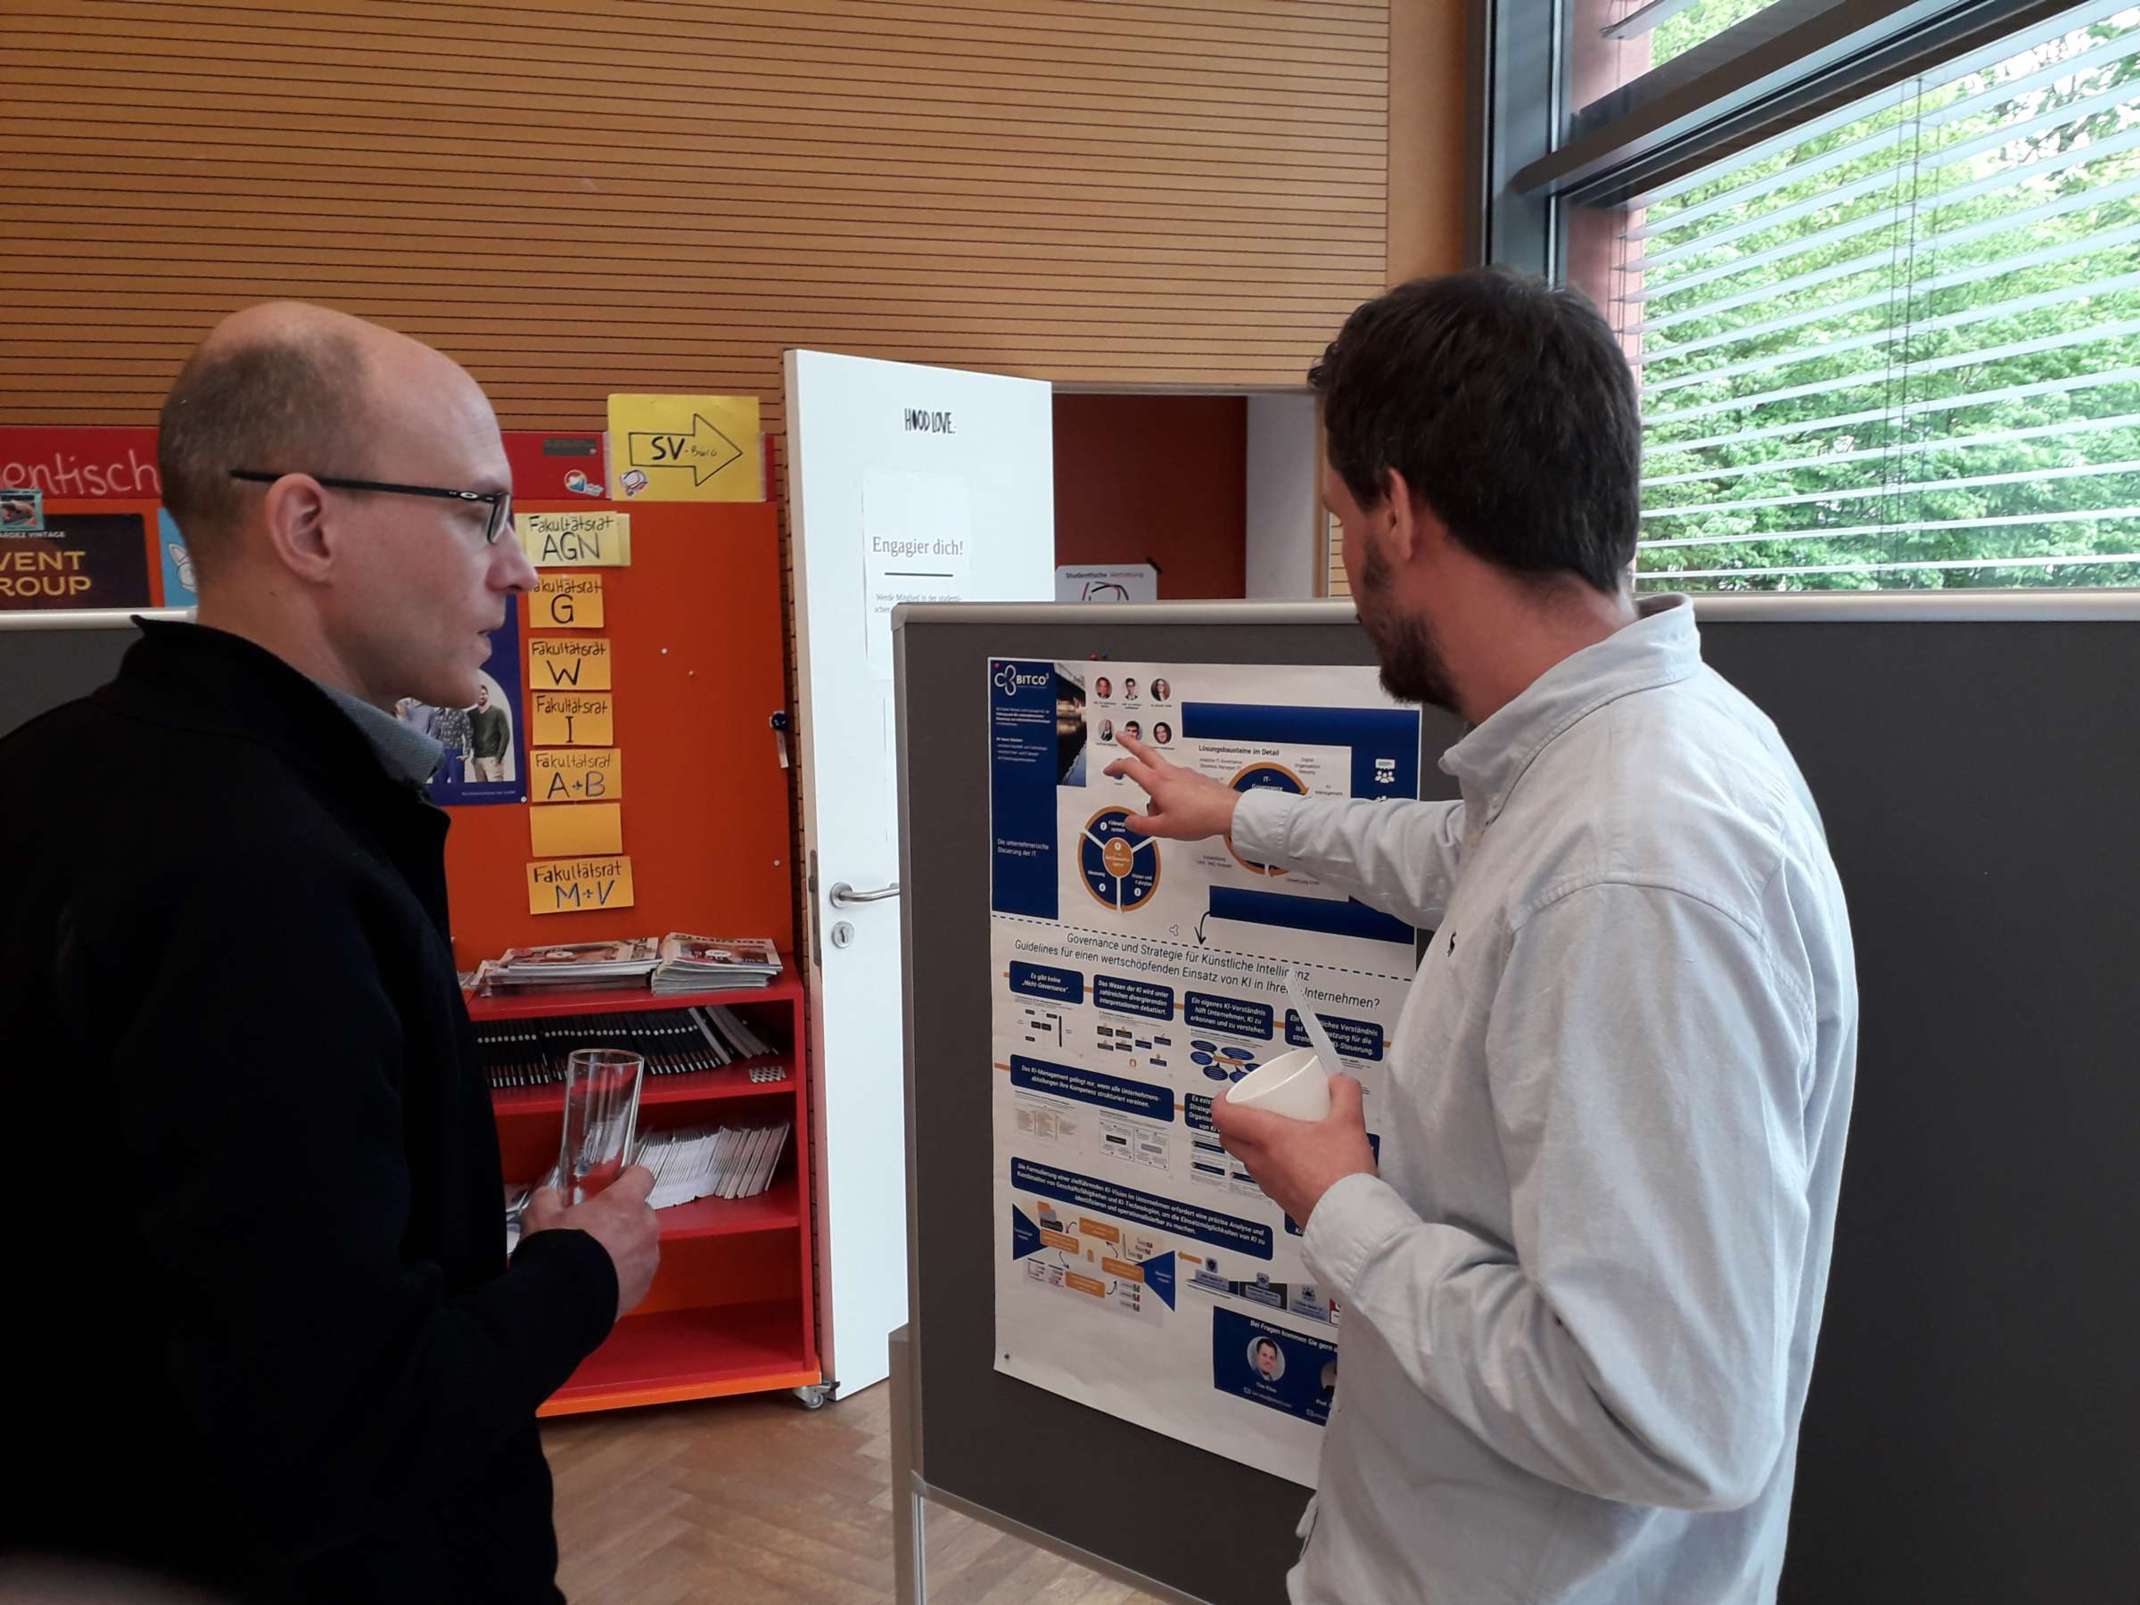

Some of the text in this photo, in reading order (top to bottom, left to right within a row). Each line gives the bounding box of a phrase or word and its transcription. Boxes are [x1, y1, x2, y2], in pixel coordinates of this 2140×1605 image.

[542, 531, 600, 561] AGN
[872, 536, 963, 557] Engagier dich!
[534, 578, 603, 594] akultätsrat
[551, 593, 574, 625] G
[546, 658, 581, 685] W
[565, 716, 574, 743] I
[1253, 747, 1261, 755] im
[1262, 746, 1280, 756] Detail
[533, 860, 622, 883] Fakultätsrat
[1015, 940, 1058, 956] Guidelines
[1060, 946, 1073, 958] für
[1074, 950, 1099, 962] einen
[1182, 967, 1218, 982] Einsatz
[1220, 973, 1239, 985] von
[1241, 975, 1251, 988] KI
[1254, 978, 1264, 989] in
[1266, 980, 1289, 994] Ihre
[1067, 933, 1310, 982] Governance und Strategie für Künstliche Intellinz
[1201, 1000, 1223, 1009] eigenes
[1250, 1320, 1260, 1329] Bei
[1260, 1323, 1280, 1335] Fragen
[1308, 1338, 1318, 1346] Sie
